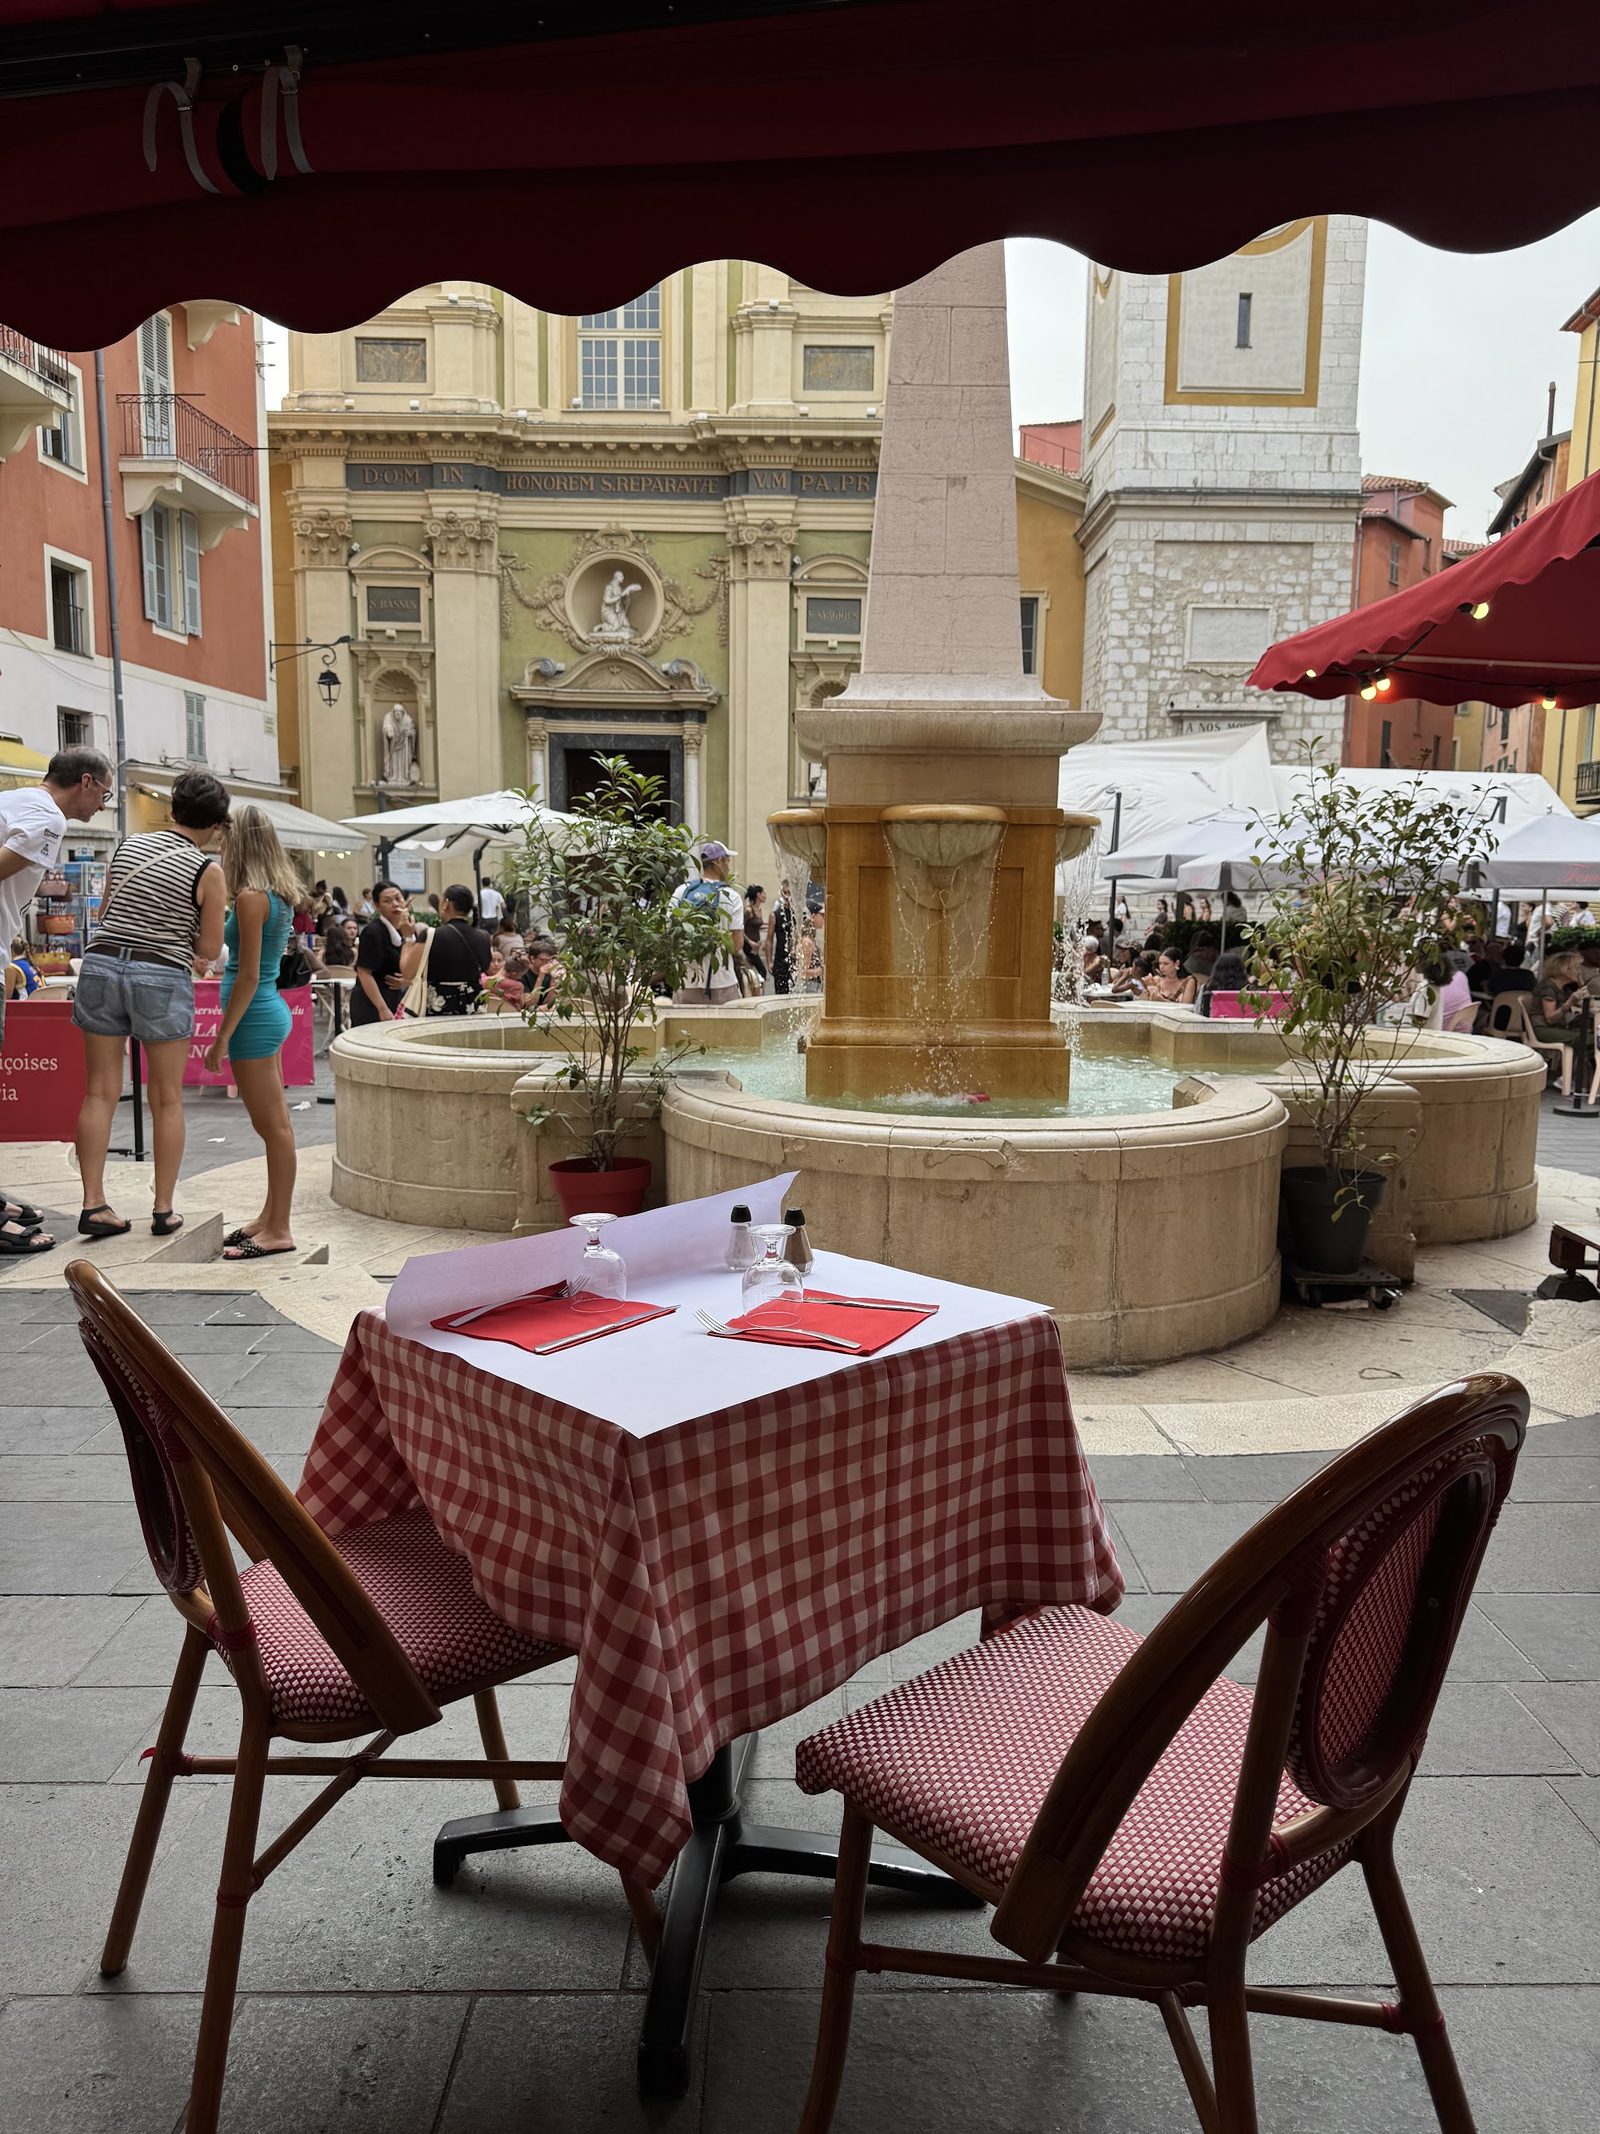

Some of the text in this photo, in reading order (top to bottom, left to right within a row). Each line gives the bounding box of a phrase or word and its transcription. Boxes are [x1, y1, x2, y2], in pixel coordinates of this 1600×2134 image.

[441, 466, 464, 483] IN
[506, 475, 594, 492] HONOREM
[1199, 722, 1221, 732] NOS
